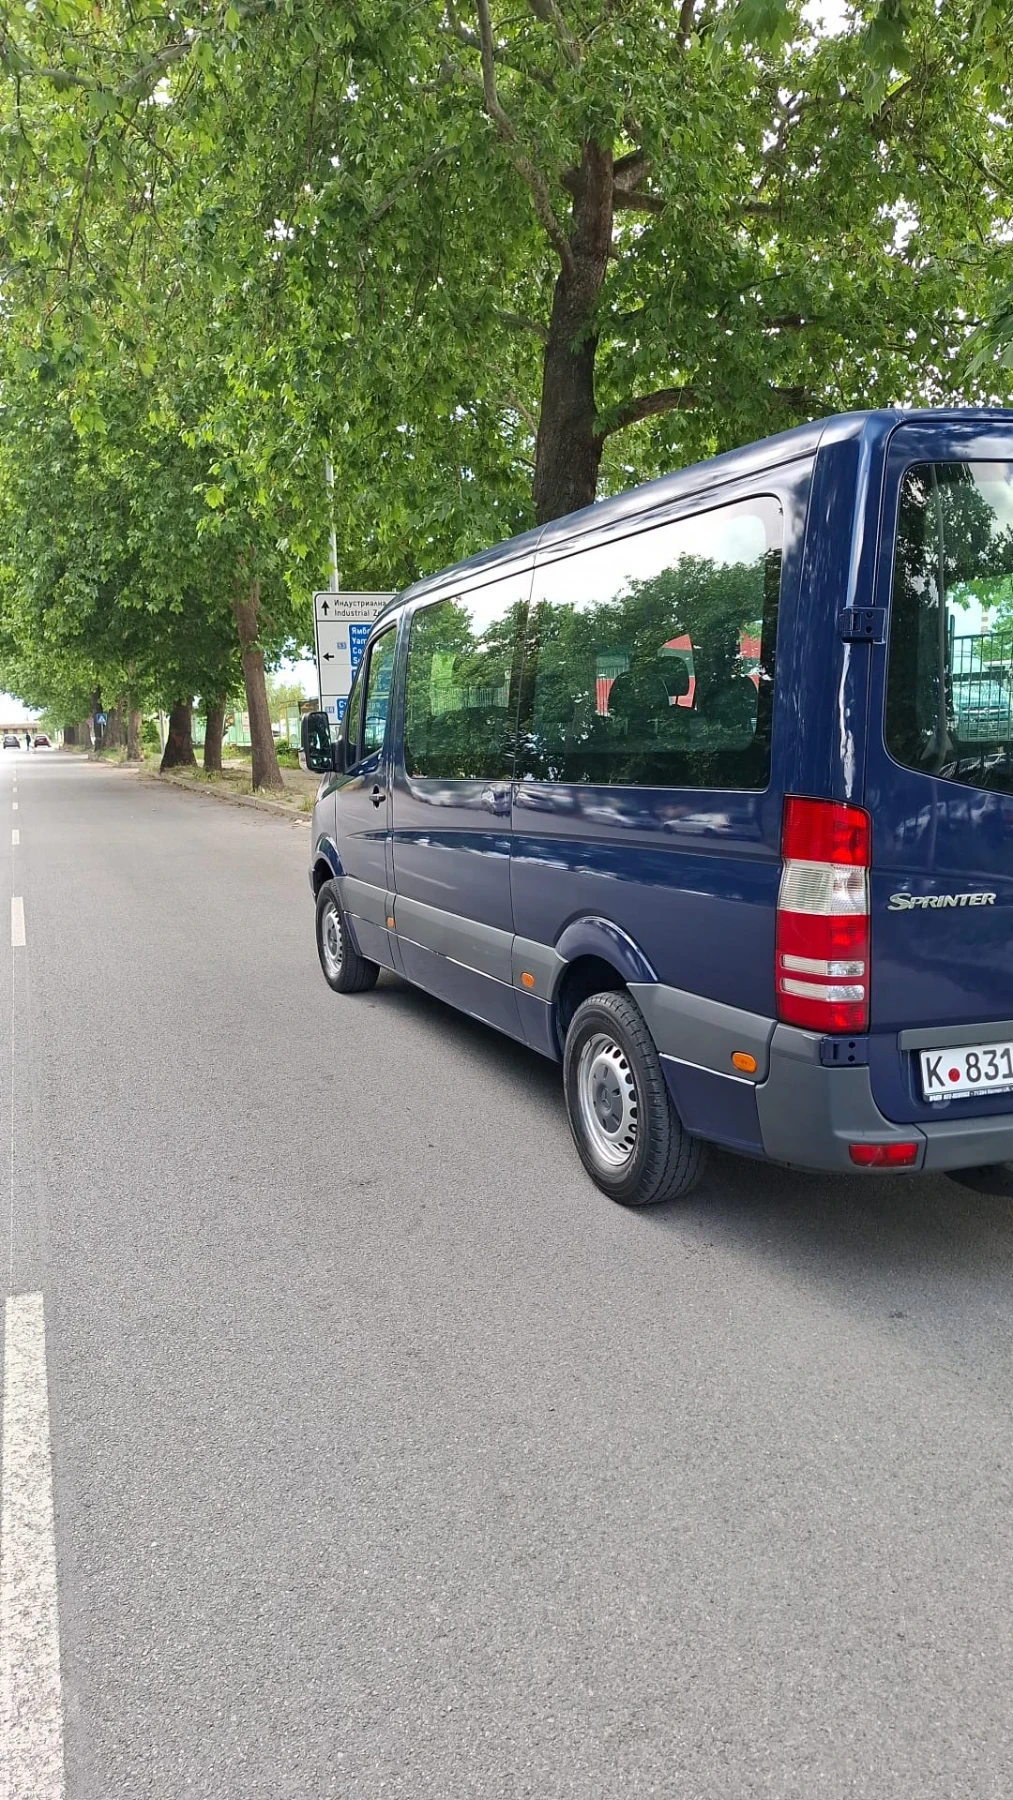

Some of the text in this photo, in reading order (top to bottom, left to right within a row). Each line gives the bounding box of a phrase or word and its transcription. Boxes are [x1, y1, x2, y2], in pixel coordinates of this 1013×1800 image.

[334, 599, 387, 609] Индустриална
[334, 609, 370, 617] Industrial
[887, 892, 996, 911] SPRINTER
[965, 1047, 1013, 1083] 831
